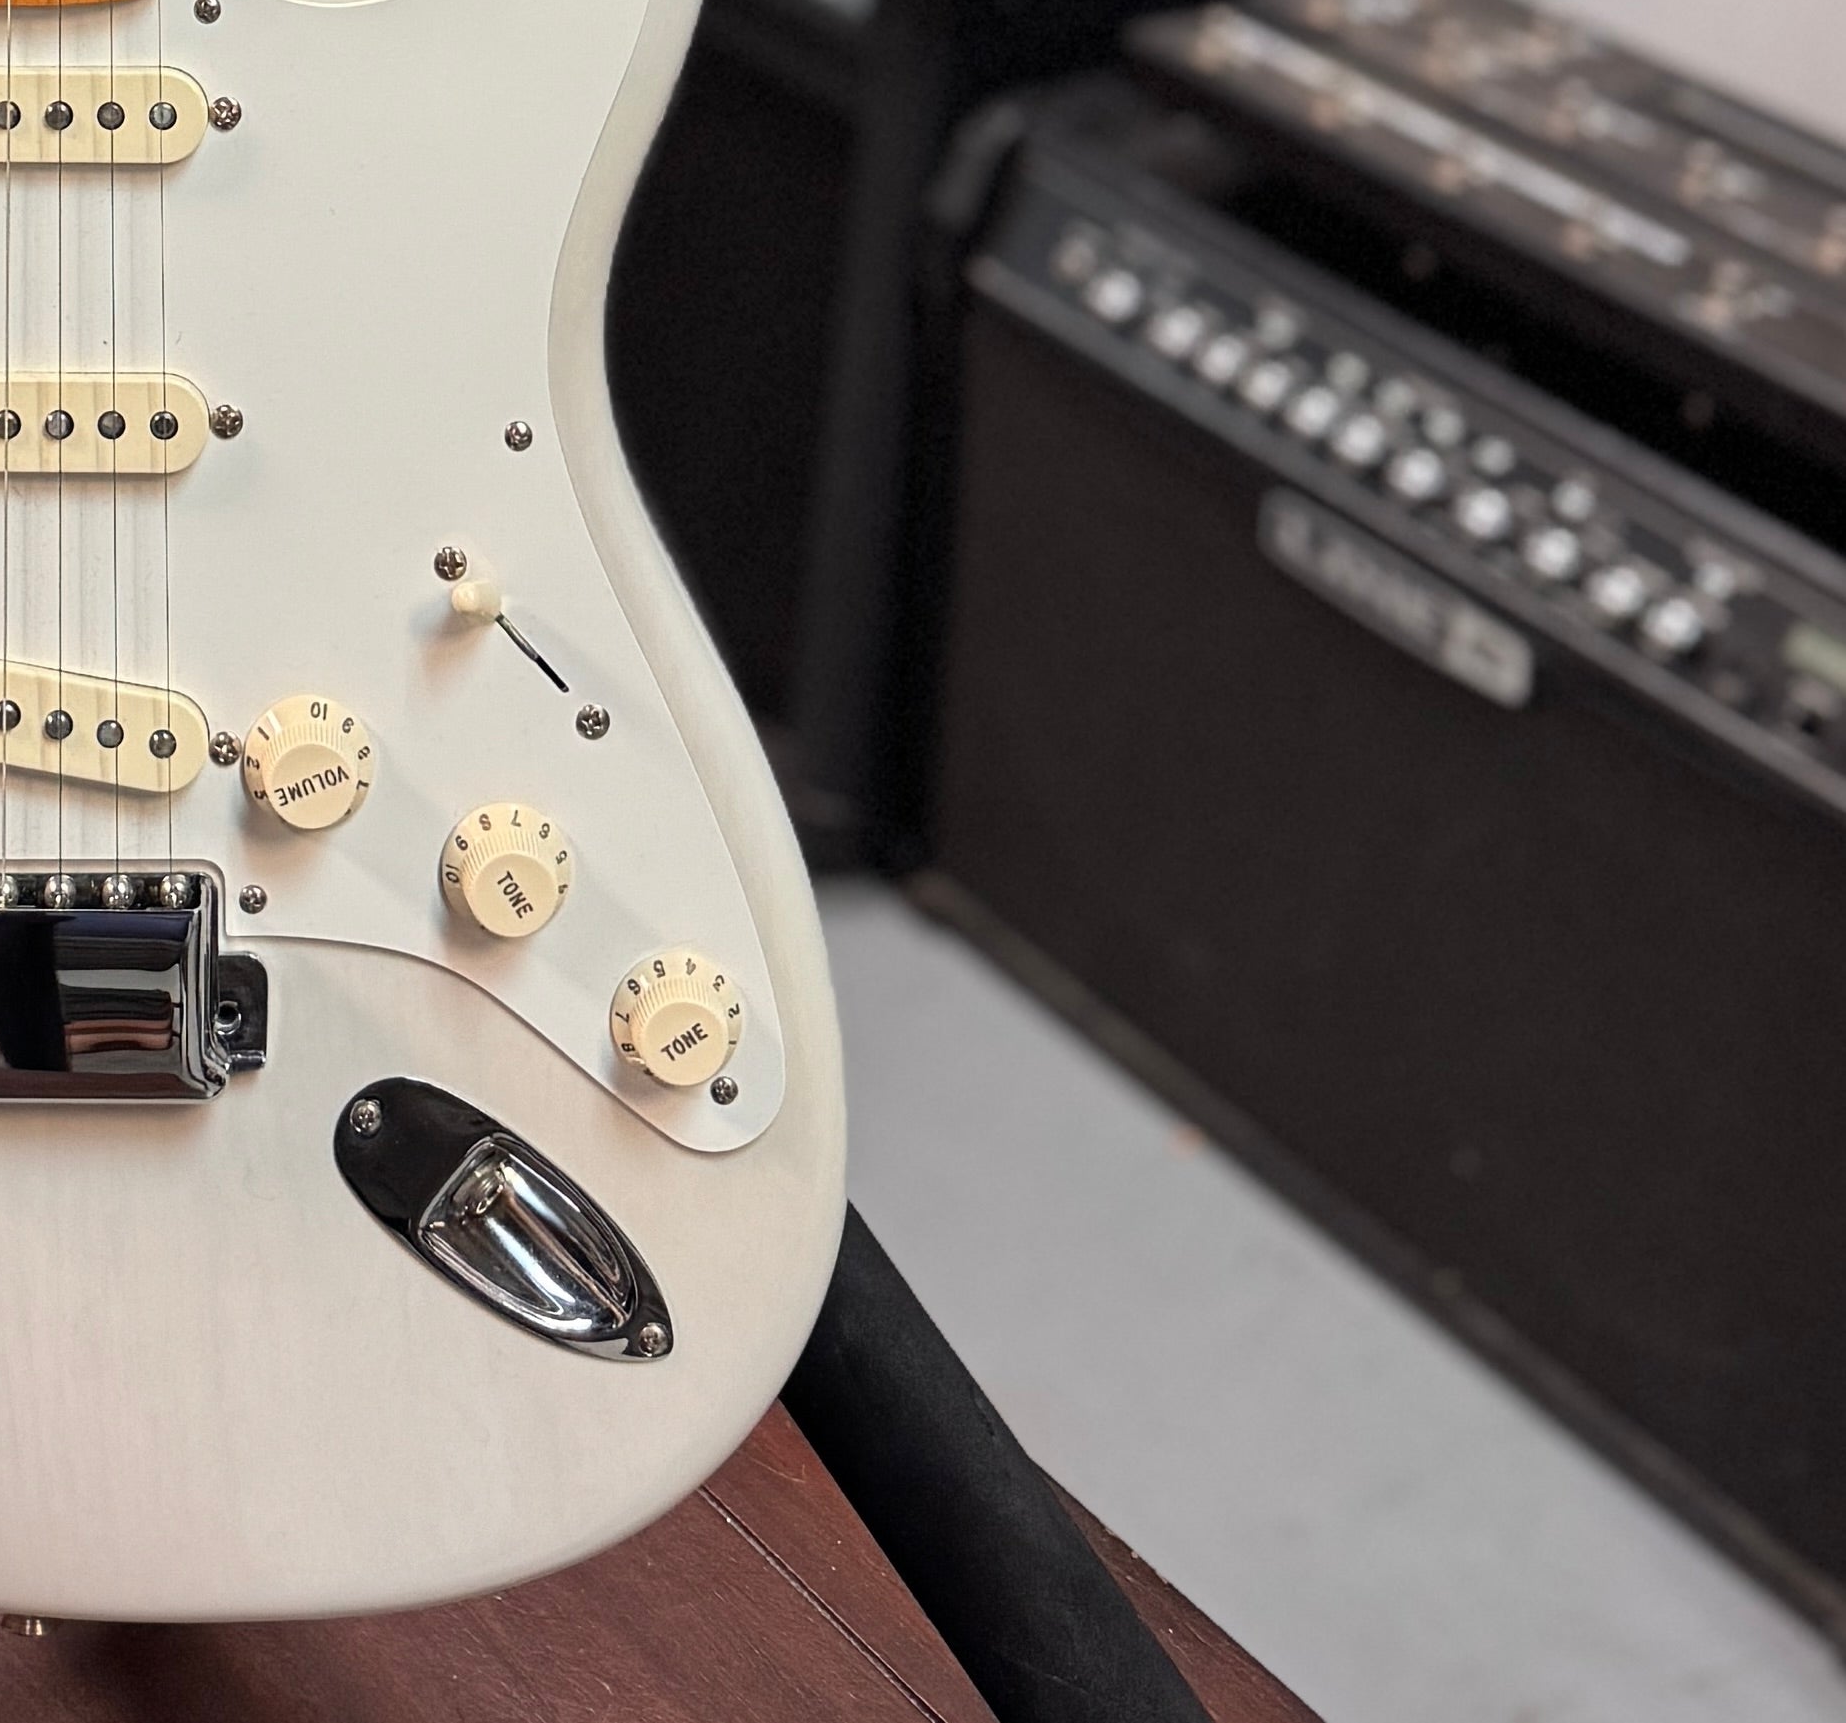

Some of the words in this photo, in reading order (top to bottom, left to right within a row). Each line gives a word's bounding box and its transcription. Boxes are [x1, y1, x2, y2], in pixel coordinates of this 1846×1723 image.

[310, 701, 328, 721] 10
[257, 726, 270, 741] 1
[357, 745, 371, 760] 8
[246, 755, 260, 771] 2
[274, 765, 350, 807] VOLUME
[479, 813, 492, 831] 8
[510, 809, 522, 827] 7
[445, 863, 460, 884] 10
[496, 870, 534, 919] TONE
[653, 959, 666, 978] 5
[627, 978, 641, 995] 6
[713, 974, 725, 992] 3
[615, 1011, 630, 1024] 7
[728, 1003, 740, 1018] 2
[660, 1022, 709, 1061] TONE
